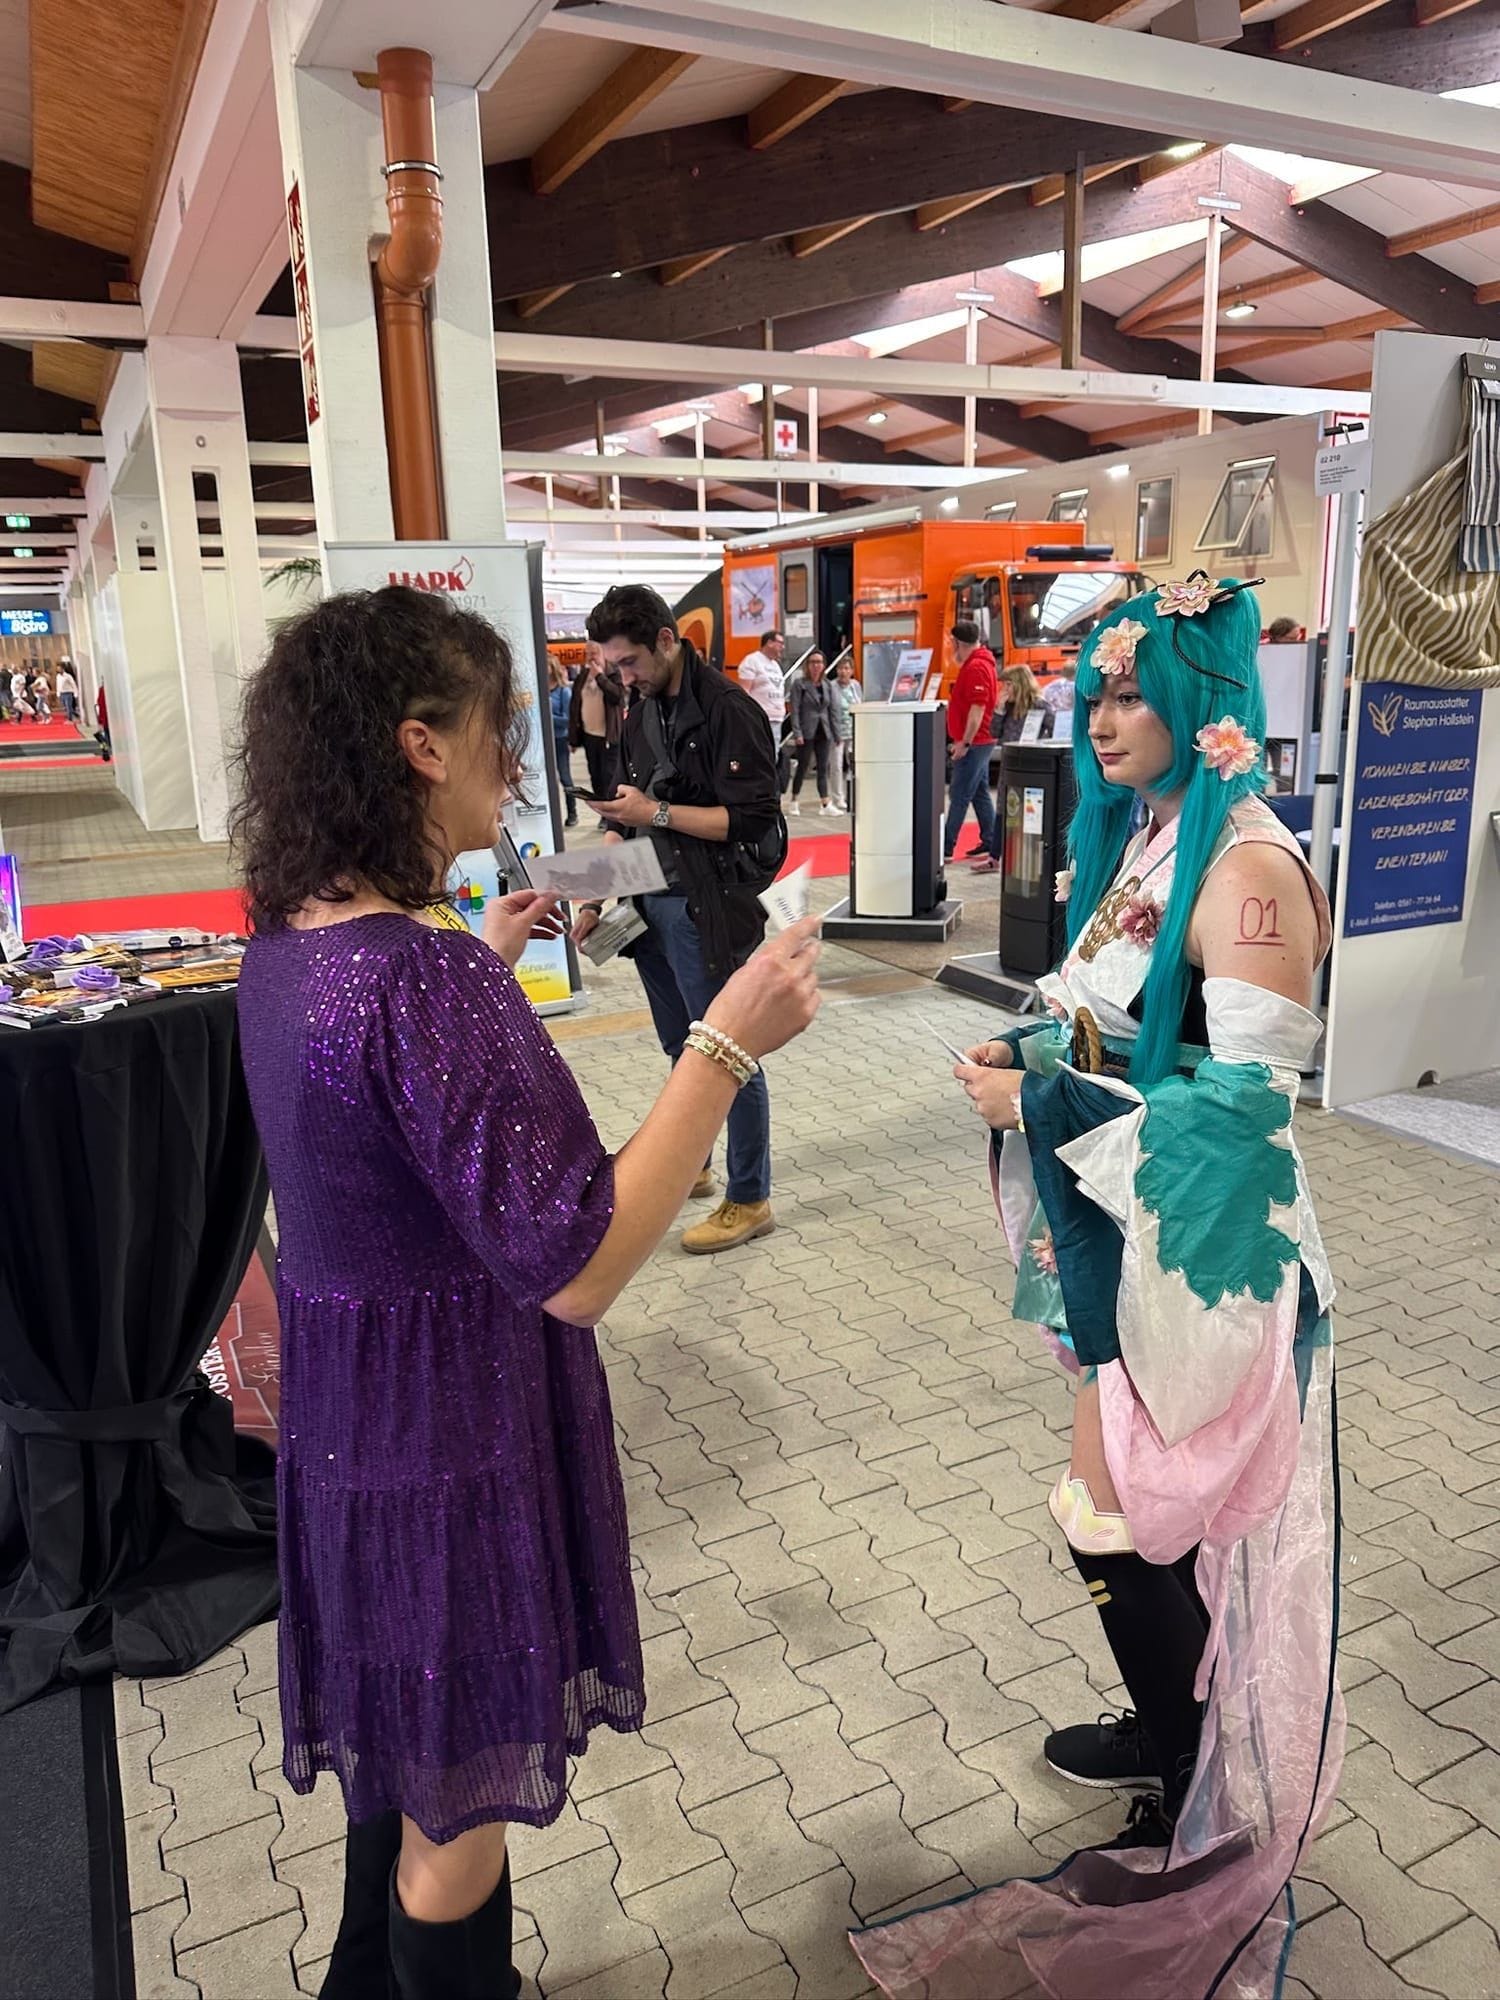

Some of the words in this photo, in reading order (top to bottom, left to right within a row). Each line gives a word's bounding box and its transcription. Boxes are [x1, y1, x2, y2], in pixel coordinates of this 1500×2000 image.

[389, 571, 466, 591] HARK
[1, 610, 33, 620] MESSE
[11, 618, 48, 635] Bistro
[1403, 697, 1470, 711] Raumausstatter
[1402, 715, 1438, 731] Stephan
[1439, 713, 1474, 726] Hollstein
[1361, 763, 1410, 779] KOMMEN
[1409, 760, 1427, 775] SIE
[1358, 788, 1443, 810] LADENGESCHÄFT
[1443, 788, 1469, 803] ODER
[1370, 821, 1442, 840] VEREINBAREN
[1440, 818, 1457, 833] SIE
[1374, 855, 1409, 871] EINEN
[1408, 849, 1449, 867] TERMIN!
[1240, 897, 1283, 940] 01
